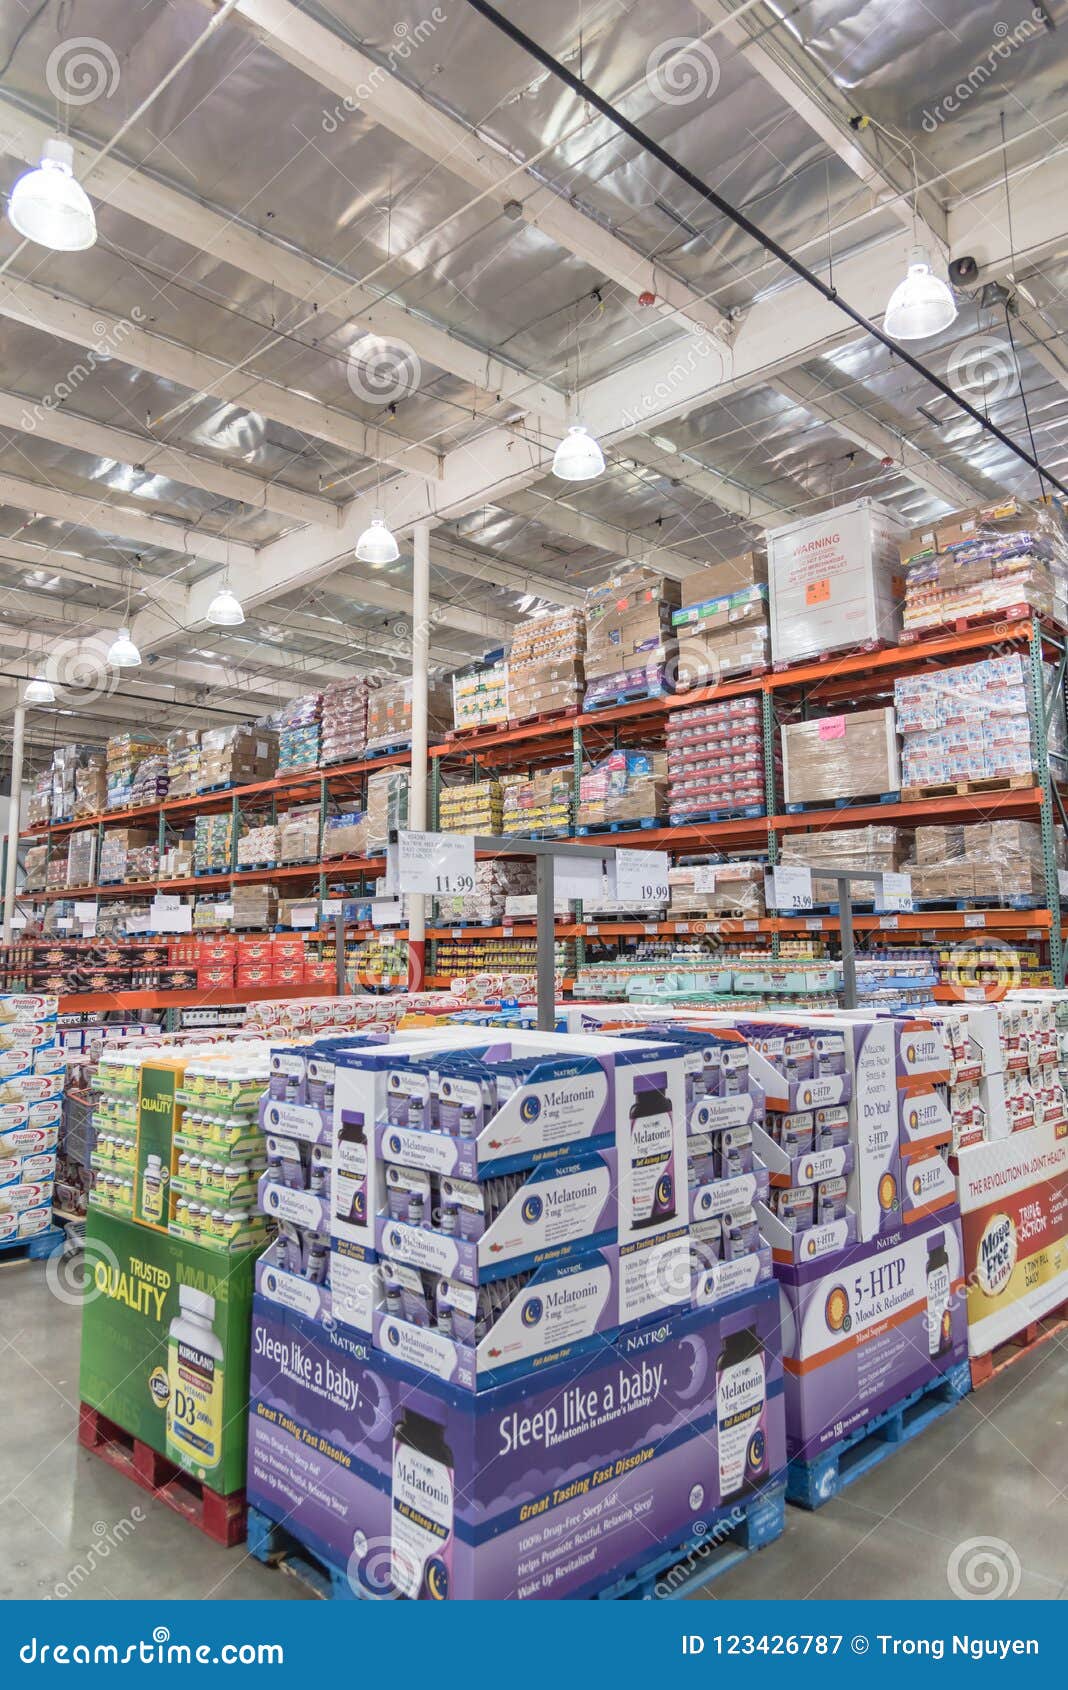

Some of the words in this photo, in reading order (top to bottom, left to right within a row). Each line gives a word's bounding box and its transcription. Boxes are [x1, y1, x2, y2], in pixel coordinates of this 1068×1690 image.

[794, 534, 840, 556] WARNING
[436, 875, 474, 892] 11.99
[642, 885, 668, 899] 19.99
[793, 895, 811, 907] 23.99
[916, 1042, 936, 1055] 5-HTP
[544, 1087, 594, 1107] Melatonin
[813, 1086, 831, 1098] 5-HTP
[141, 1098, 171, 1113] QUALITY
[543, 1110, 547, 1118] 5
[549, 1110, 560, 1119] mg
[864, 1104, 874, 1118] Do
[875, 1100, 891, 1115] You?
[919, 1105, 938, 1119] 5-HTP
[402, 1138, 434, 1154] Melatonin
[633, 1127, 671, 1144] Melatonin
[869, 1131, 888, 1145] 5-HTP
[814, 1158, 833, 1170] 5-HTP
[969, 1180, 982, 1197] THE
[984, 1165, 1022, 1192] REVOLUTION
[1023, 1161, 1029, 1176] IN
[1030, 1155, 1047, 1173] JOINT
[1047, 1147, 1066, 1166] HEALTH
[921, 1168, 941, 1185] 5-HTP
[546, 1182, 597, 1207] Melatonin
[545, 1209, 549, 1218] 5
[550, 1209, 561, 1218] mg
[1019, 1201, 1041, 1223] TRIPLE
[817, 1231, 836, 1245] 5-HTP
[1020, 1215, 1047, 1242] ACTION
[876, 1232, 902, 1250] NATROL
[981, 1220, 1010, 1262] Move
[129, 1256, 171, 1289] TRUSTED
[986, 1243, 1009, 1280] Free
[1027, 1258, 1039, 1271] TINY
[1040, 1255, 1049, 1266] PILL
[854, 1257, 905, 1306] 5-HTP
[930, 1275, 948, 1290] 5-HTP
[990, 1262, 1011, 1289] ULTRA
[1025, 1271, 1039, 1287] DAILY
[95, 1260, 167, 1322] QUALITY
[546, 1282, 598, 1309] Melatonin
[545, 1312, 550, 1320] 5
[551, 1310, 562, 1320] mg
[855, 1304, 876, 1324] Mood
[876, 1304, 883, 1314] &
[884, 1288, 915, 1311] Relaxation
[330, 1332, 370, 1361] NATROL
[401, 1331, 433, 1354] Melatonin
[627, 1324, 672, 1351] NATROL
[856, 1330, 870, 1344] Mood
[179, 1345, 214, 1371] KIRKLAND
[254, 1327, 288, 1373] Sleep
[291, 1341, 312, 1380] like
[315, 1362, 322, 1385] a
[326, 1359, 363, 1411] baby.
[153, 1378, 169, 1398] USP
[184, 1383, 206, 1401] VITAMIN
[283, 1366, 305, 1386] Melatonin
[311, 1385, 331, 1399] nature's
[721, 1372, 763, 1402] Melatonin
[175, 1389, 195, 1426] D3
[499, 1407, 557, 1456] Sleep
[563, 1387, 597, 1428] like
[603, 1384, 613, 1411] a
[619, 1361, 668, 1404] baby.
[724, 1415, 733, 1428] Fall
[734, 1409, 751, 1423] Asleep
[752, 1403, 761, 1415] Fast
[550, 1422, 589, 1446] Melatonin
[591, 1417, 596, 1429] is
[597, 1407, 627, 1425] nature's
[627, 1396, 653, 1412] lullaby.
[257, 1403, 276, 1421] Great
[278, 1412, 301, 1440] Tasting
[302, 1430, 318, 1448] Fast
[319, 1441, 351, 1468] Dissolve
[398, 1462, 449, 1505] Melatonin
[520, 1496, 550, 1521] Great
[552, 1479, 590, 1504] Tasting
[592, 1466, 613, 1486] Fast
[615, 1448, 654, 1475] Dissolve
[399, 1503, 409, 1515] Fall
[410, 1509, 431, 1530] Asleep
[433, 1523, 446, 1537] Fast
[519, 1535, 541, 1552] 100%
[543, 1514, 580, 1540] Drug-Free
[583, 1500, 602, 1519] Sleep
[518, 1559, 541, 1577] Helps
[542, 1540, 573, 1563] Promote
[575, 1523, 601, 1546] Restful,
[603, 1510, 633, 1531] Relaxing
[518, 1581, 540, 1599] Wake
[542, 1573, 554, 1587] Up
